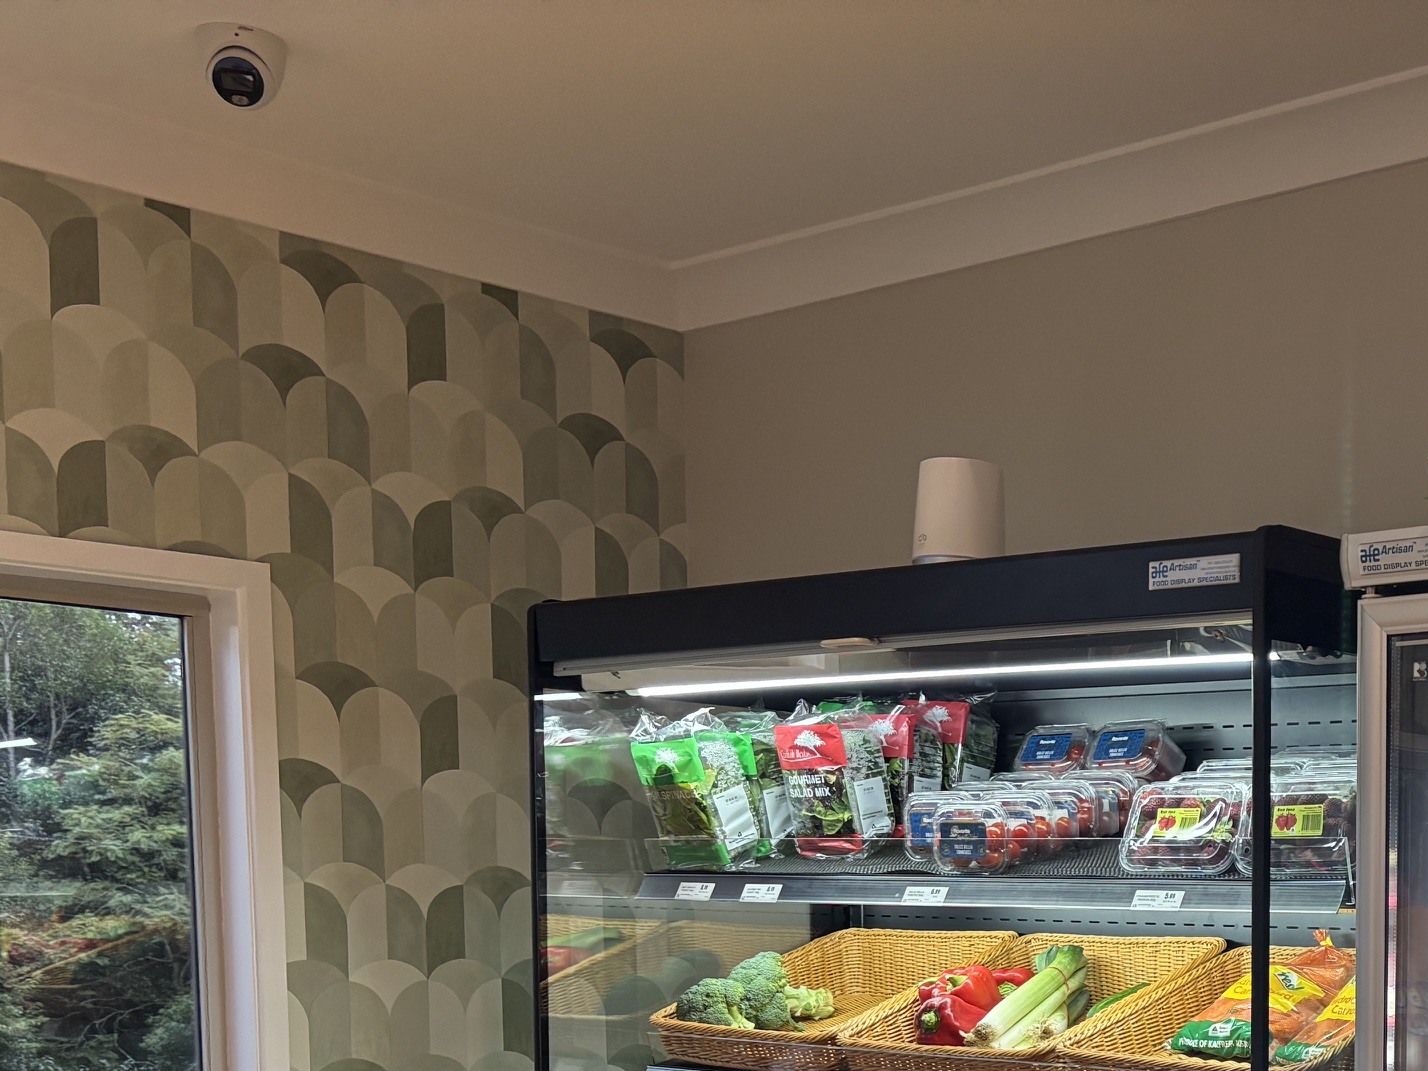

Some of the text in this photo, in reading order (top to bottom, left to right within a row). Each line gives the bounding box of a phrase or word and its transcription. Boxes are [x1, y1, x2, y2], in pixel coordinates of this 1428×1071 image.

[1381, 543, 1414, 555] Artisan
[1168, 561, 1198, 572] Artisan
[1363, 564, 1382, 572] FOOD
[1383, 560, 1413, 570] DISPLAY
[1152, 574, 1236, 587] FOOD DISPLAY SPECIALISTS
[788, 774, 826, 785] GOURMET
[789, 786, 831, 798] SALAD MIX
[1198, 1039, 1207, 1047] OF
